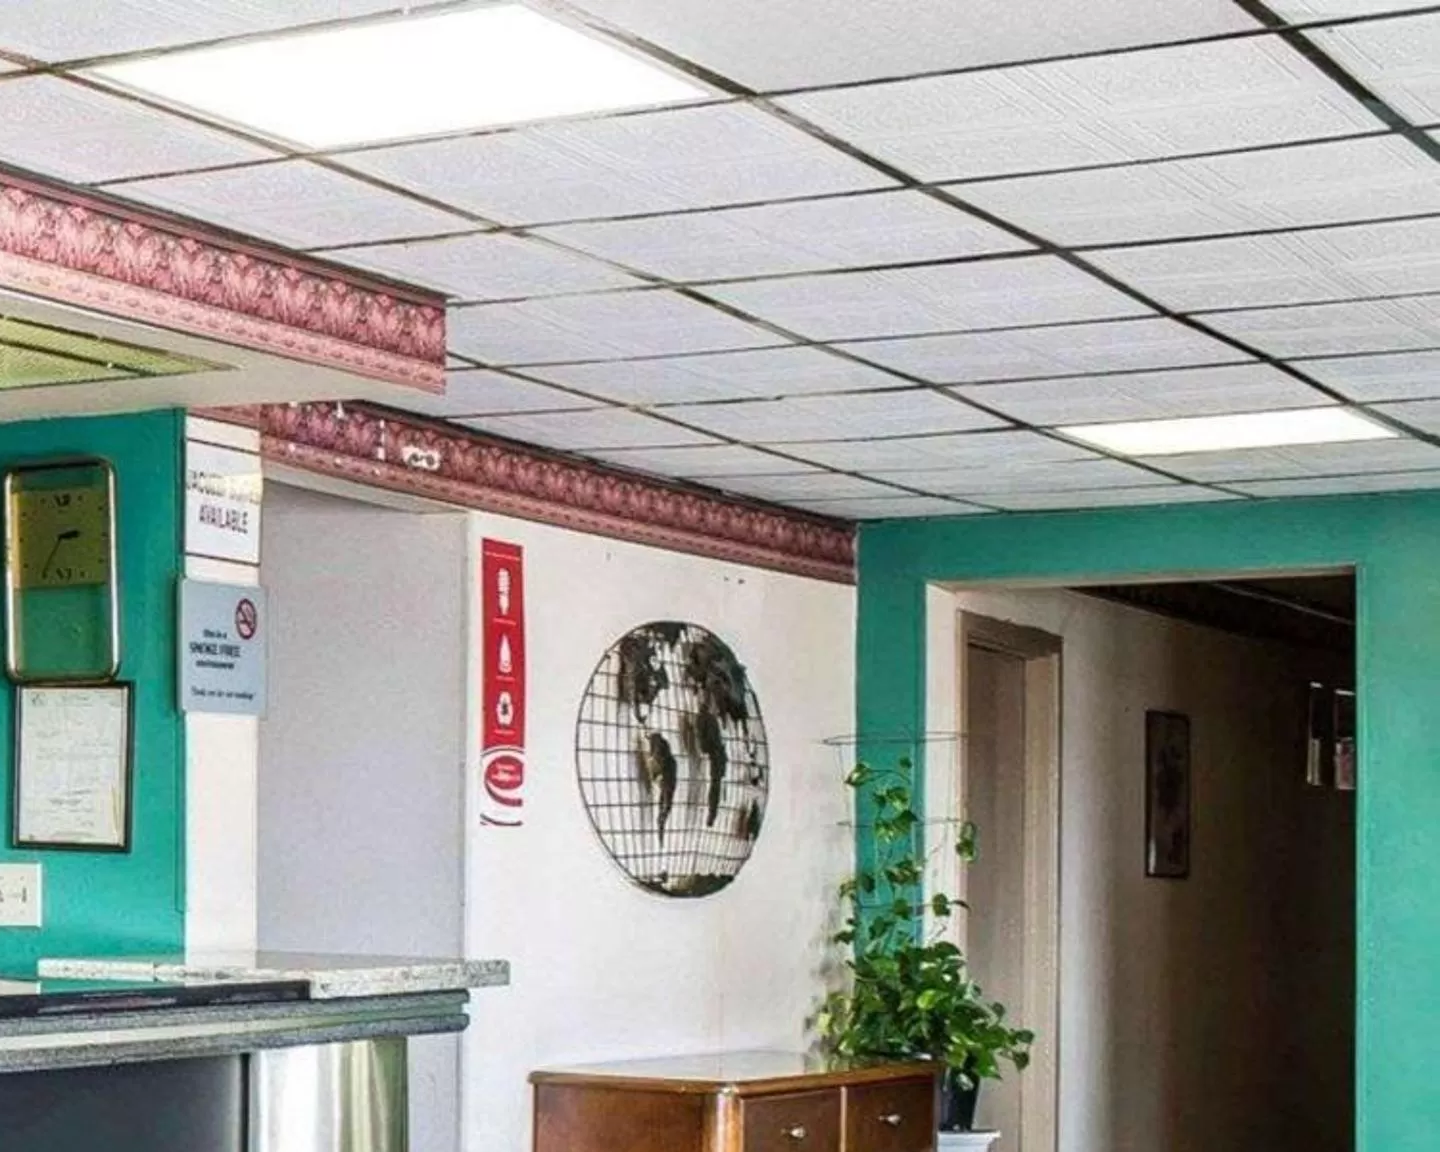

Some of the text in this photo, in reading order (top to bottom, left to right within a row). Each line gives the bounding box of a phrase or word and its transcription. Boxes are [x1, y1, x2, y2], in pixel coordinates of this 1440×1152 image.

[200, 505, 248, 534] AVAILABLE
[189, 641, 241, 658] SMOKE FREE
